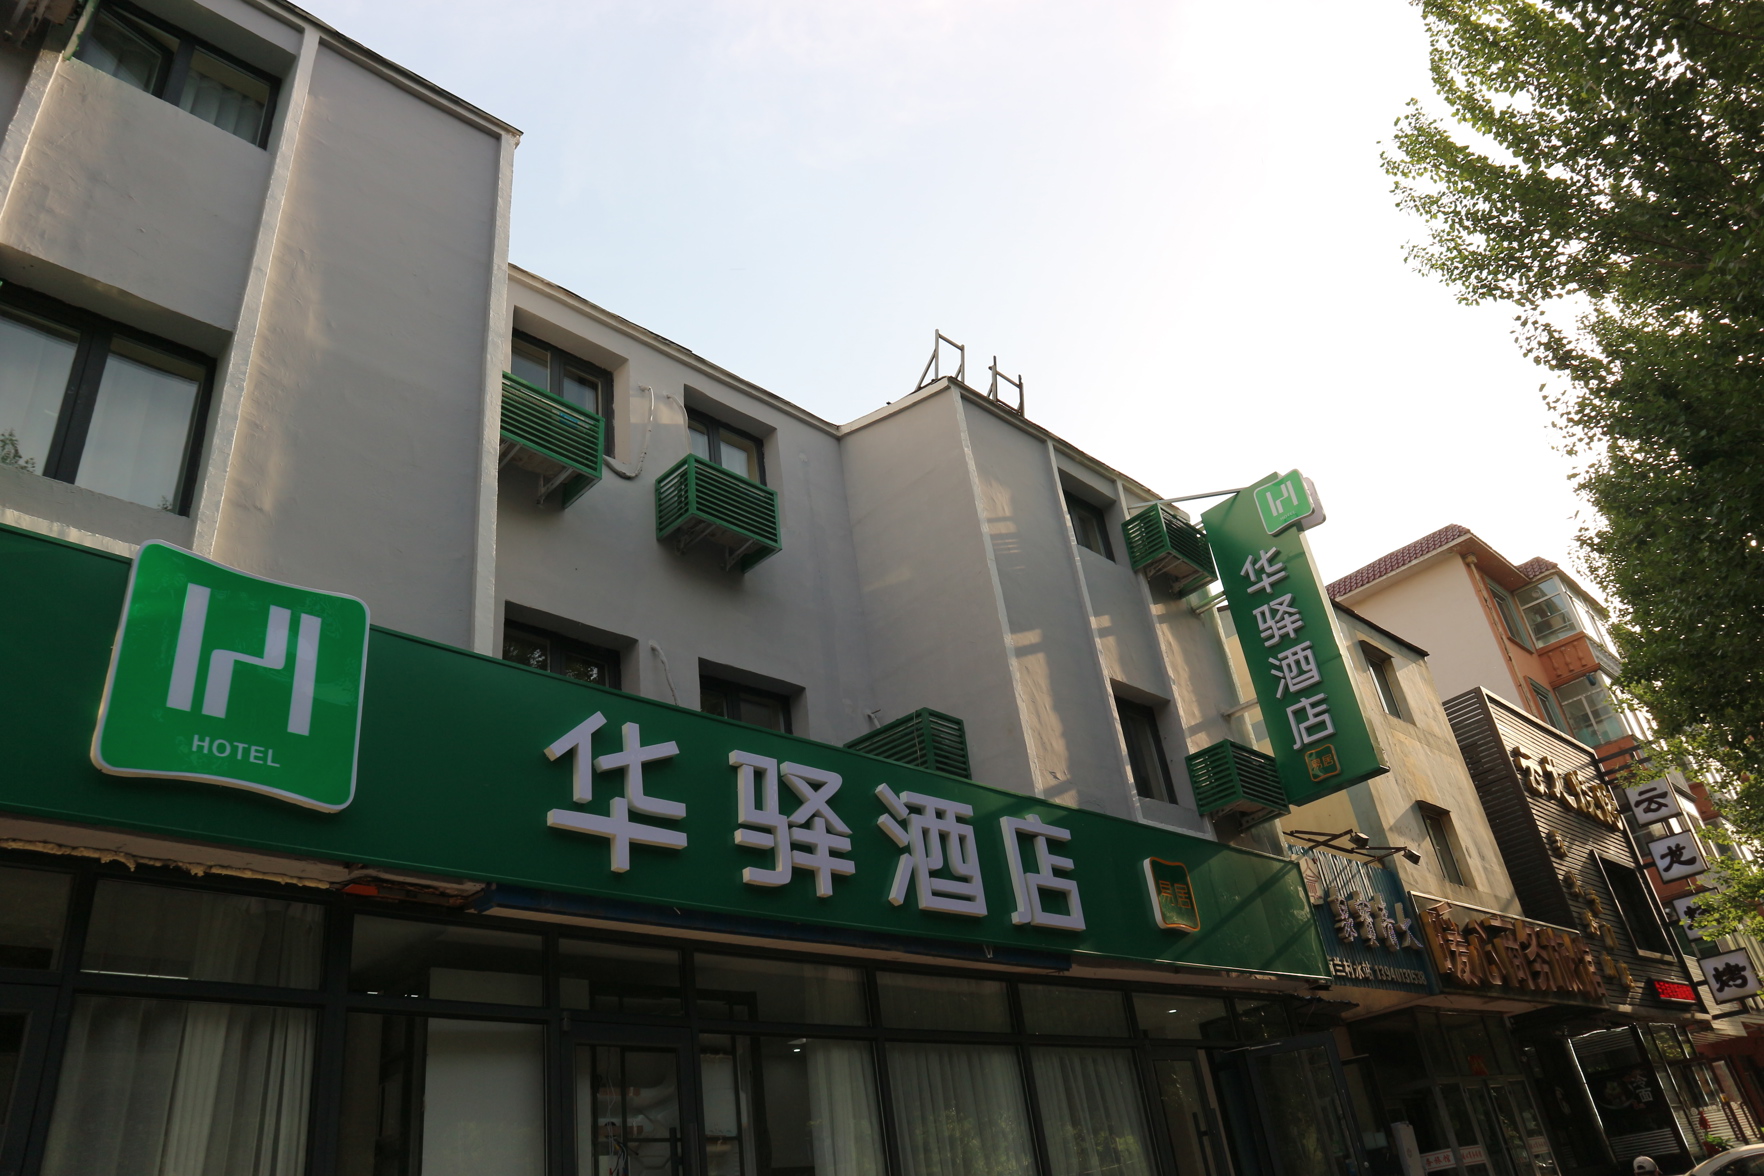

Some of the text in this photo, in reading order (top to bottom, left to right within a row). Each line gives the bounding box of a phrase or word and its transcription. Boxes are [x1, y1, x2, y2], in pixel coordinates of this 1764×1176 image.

[1279, 510, 1296, 520] HOTEL
[1240, 547, 1337, 750] 华驿酒店
[191, 734, 281, 768] HOTEL
[543, 711, 1086, 932] 华驿酒店
[1631, 1075, 1653, 1102] 冷面
